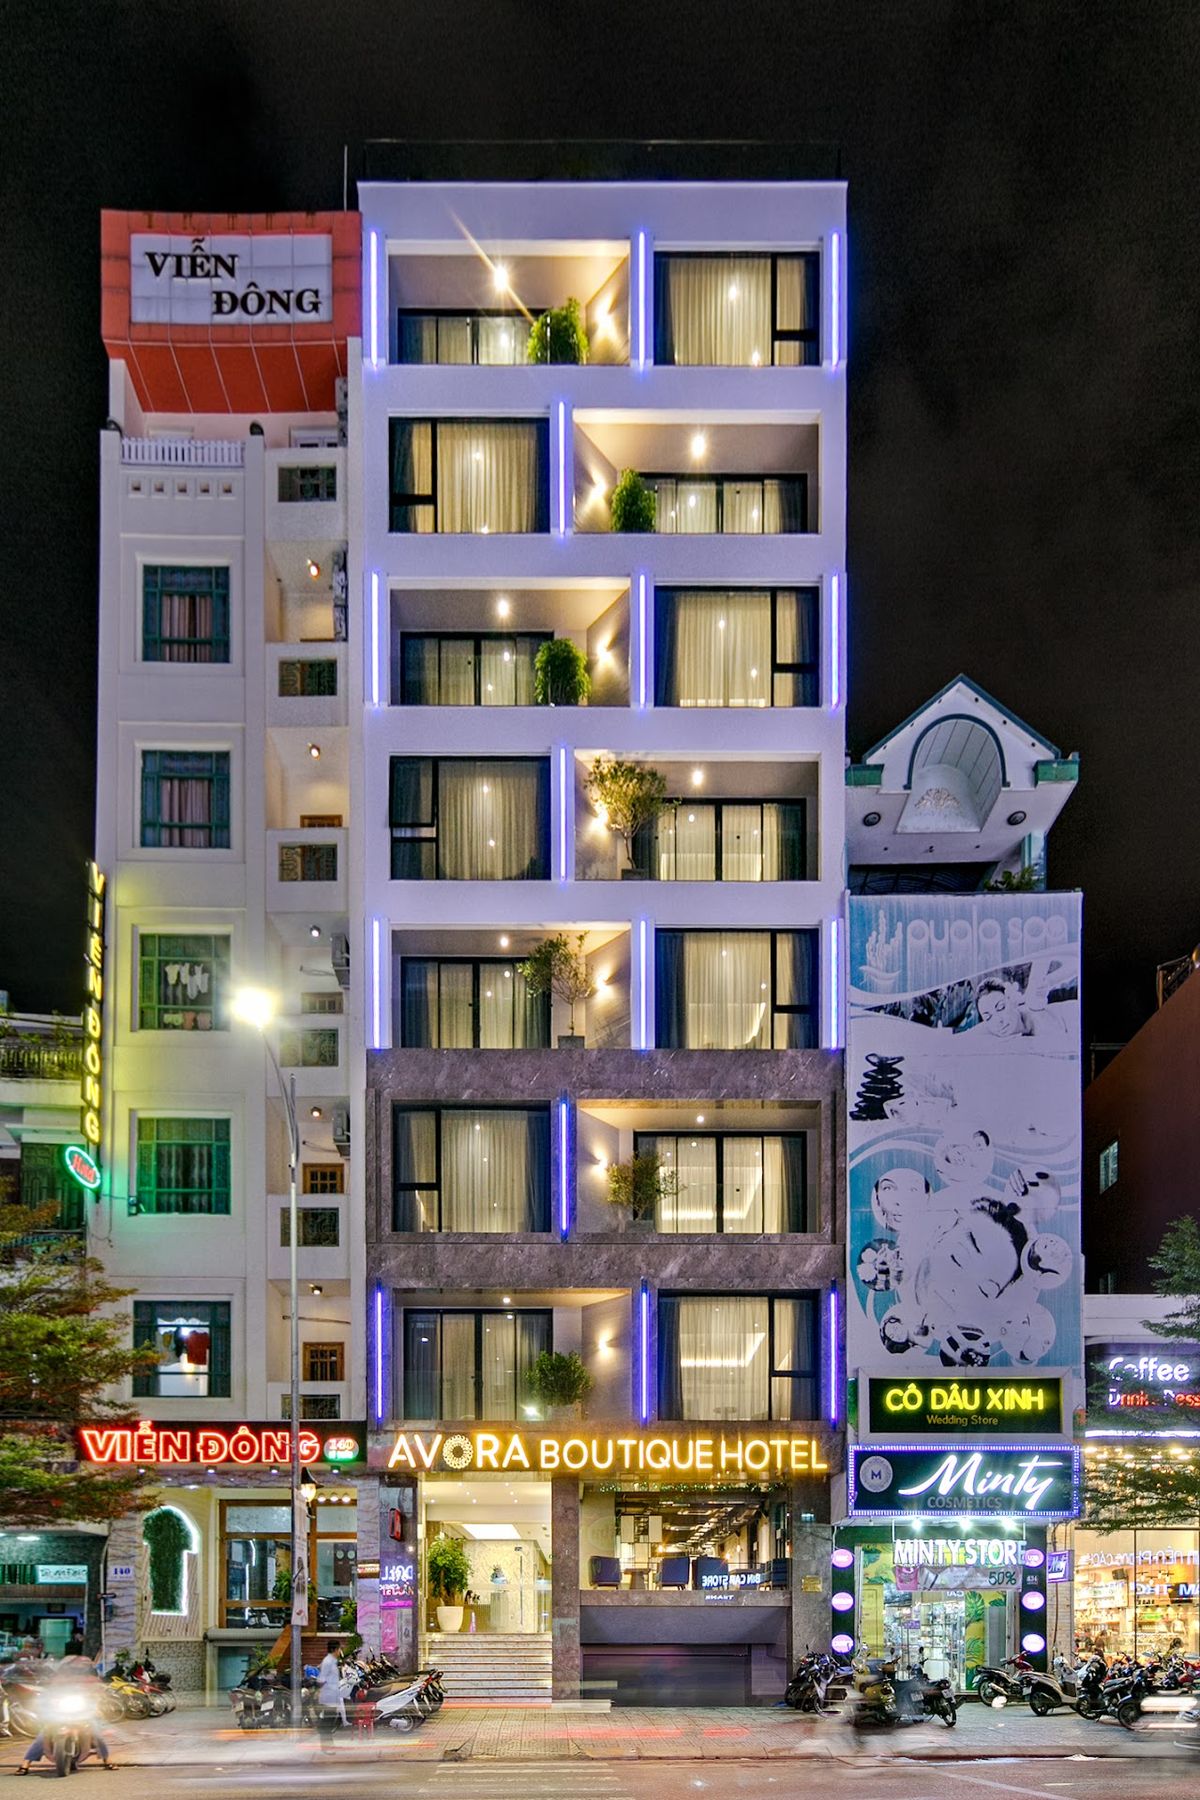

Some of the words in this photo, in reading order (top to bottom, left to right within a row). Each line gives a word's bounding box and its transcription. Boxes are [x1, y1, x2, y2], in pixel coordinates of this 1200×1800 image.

[144, 237, 239, 280] VIỄN
[211, 282, 321, 316] ĐÔNG
[1108, 1356, 1190, 1382] Coffee
[885, 1383, 923, 1411] CÔ
[930, 1383, 980, 1411] DÂU
[985, 1387, 1044, 1411] XINH
[926, 1414, 968, 1427] Wedding
[970, 1414, 998, 1426] Store
[81, 1420, 191, 1463] VIỄN
[196, 1425, 321, 1464] ĐÔNG
[386, 1432, 531, 1470] AVORA
[539, 1438, 714, 1470] BOUTIQUE
[719, 1438, 829, 1470] HOTEL
[870, 1471, 883, 1481] M
[898, 1452, 1063, 1510] Minty
[926, 1496, 1002, 1509] COSMETICS
[893, 1538, 960, 1567] MINTY
[964, 1538, 1028, 1567] STORE
[987, 1571, 1017, 1587] 50%
